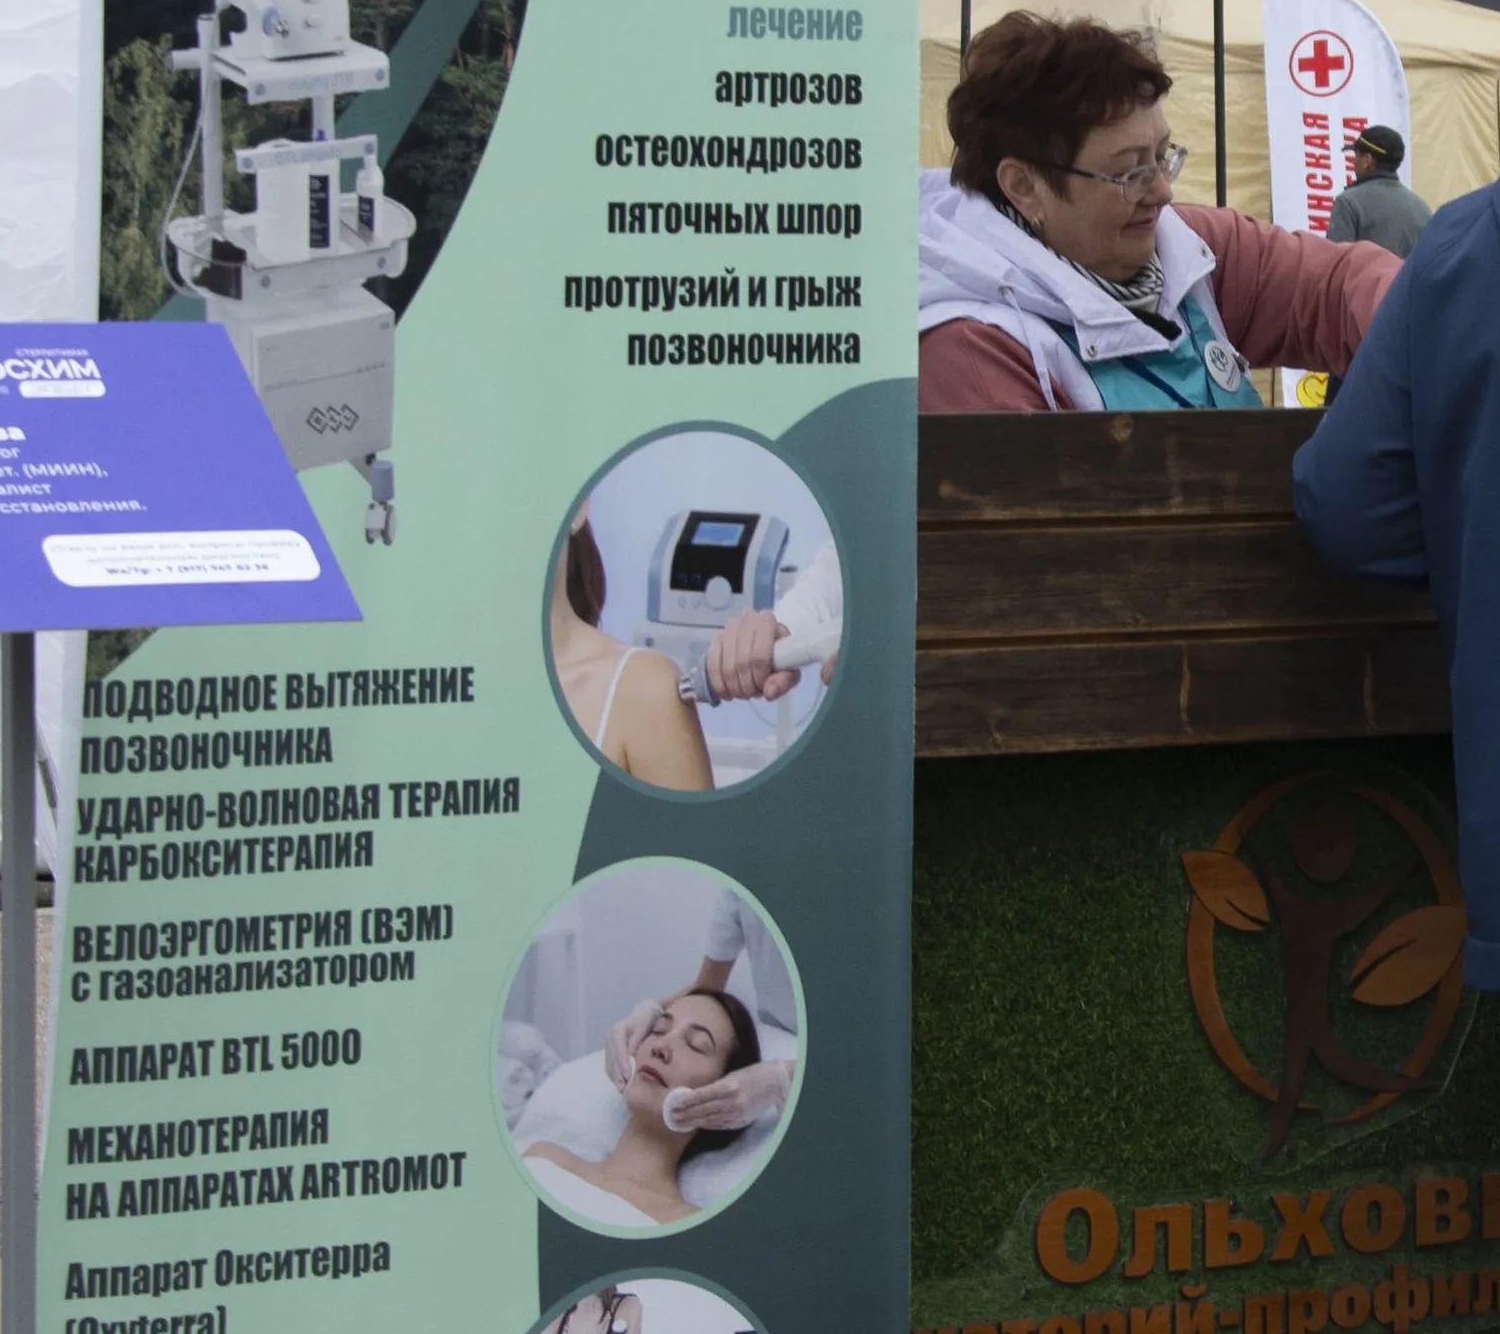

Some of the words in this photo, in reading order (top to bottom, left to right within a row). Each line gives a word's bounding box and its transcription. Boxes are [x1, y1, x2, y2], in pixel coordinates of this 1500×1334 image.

[727, 4, 863, 44] лечение
[715, 69, 863, 110] артрозов
[595, 133, 863, 174] остеохондрозов
[608, 201, 770, 237] пяточных
[777, 201, 861, 240] шпор
[564, 268, 738, 312] протрузий
[748, 273, 767, 308] и
[775, 272, 861, 312] грыж
[627, 328, 861, 367] позвоночника
[82, 678, 277, 721] ПОДВОДНОЕ
[287, 667, 474, 712] ВЫТЯЖЕНИЕ
[80, 728, 333, 775] ПОЗВОНОЧНИКА
[76, 785, 381, 837] УДАРНО-ВОЛНОВАЯ
[391, 777, 520, 819] ТЕРАПИЯ
[73, 832, 374, 883] КАРБОКСИТЕРАПИЯ
[73, 910, 352, 963] ВЕЛОЭРГОМЕТРИЯ
[361, 903, 453, 948] (ВЭМ)
[71, 972, 92, 1001] с
[98, 949, 415, 1000] газоанализатором
[70, 1039, 214, 1086] АППАРАТ
[222, 1037, 273, 1076] BTL
[281, 1029, 361, 1069] 5000
[67, 1109, 329, 1165] МЕХАНОТЕРАПИЯ
[66, 1181, 111, 1219] НА
[117, 1166, 292, 1216] АППАРАТАХ
[300, 1151, 467, 1198] ARTROMOT
[66, 1256, 208, 1301] Аппарат
[214, 1240, 391, 1290] Окситерра
